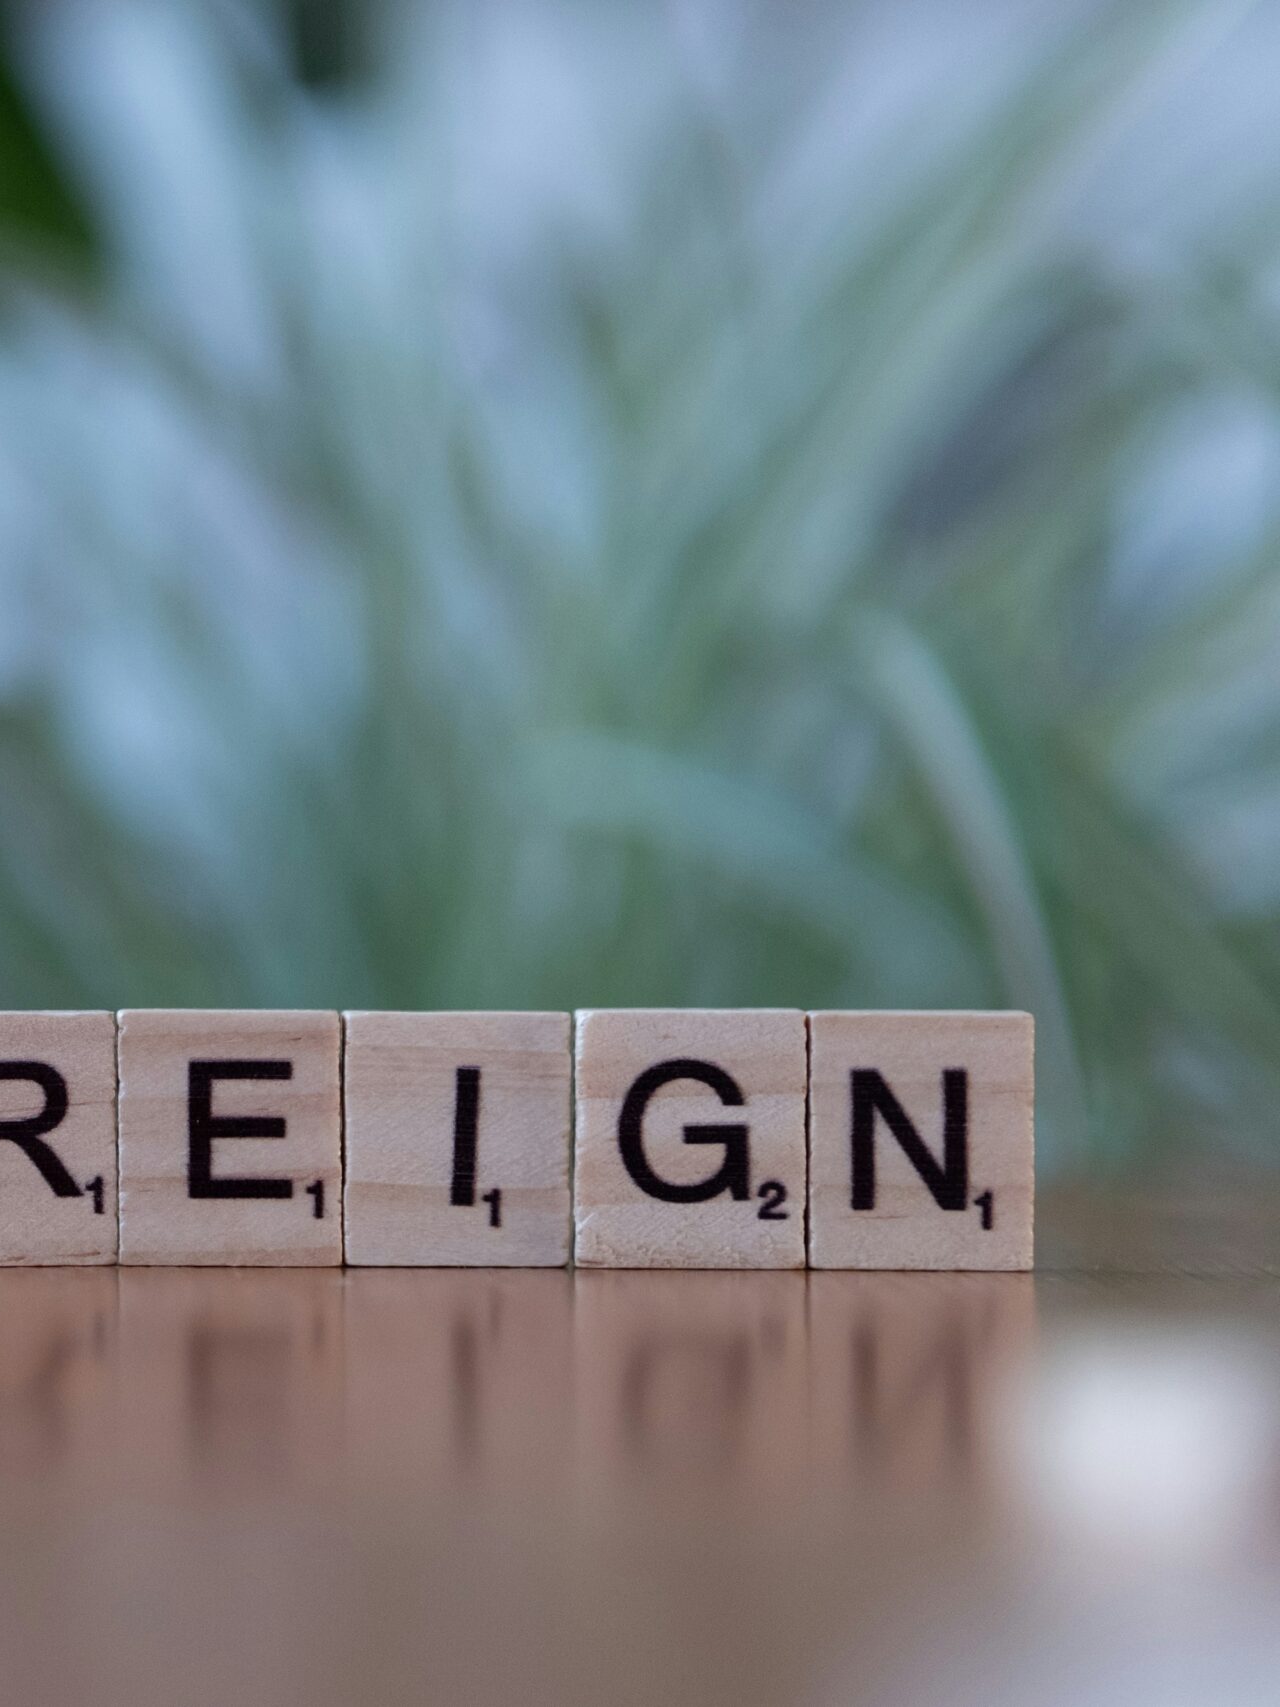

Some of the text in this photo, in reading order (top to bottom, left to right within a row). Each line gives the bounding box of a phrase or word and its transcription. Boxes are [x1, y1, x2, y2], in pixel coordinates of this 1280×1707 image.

[84, 1176, 105, 1215] 1
[305, 1178, 326, 1220] 1
[481, 1187, 503, 1229] 1
[756, 1180, 790, 1221] 2
[973, 1189, 995, 1231] 1
